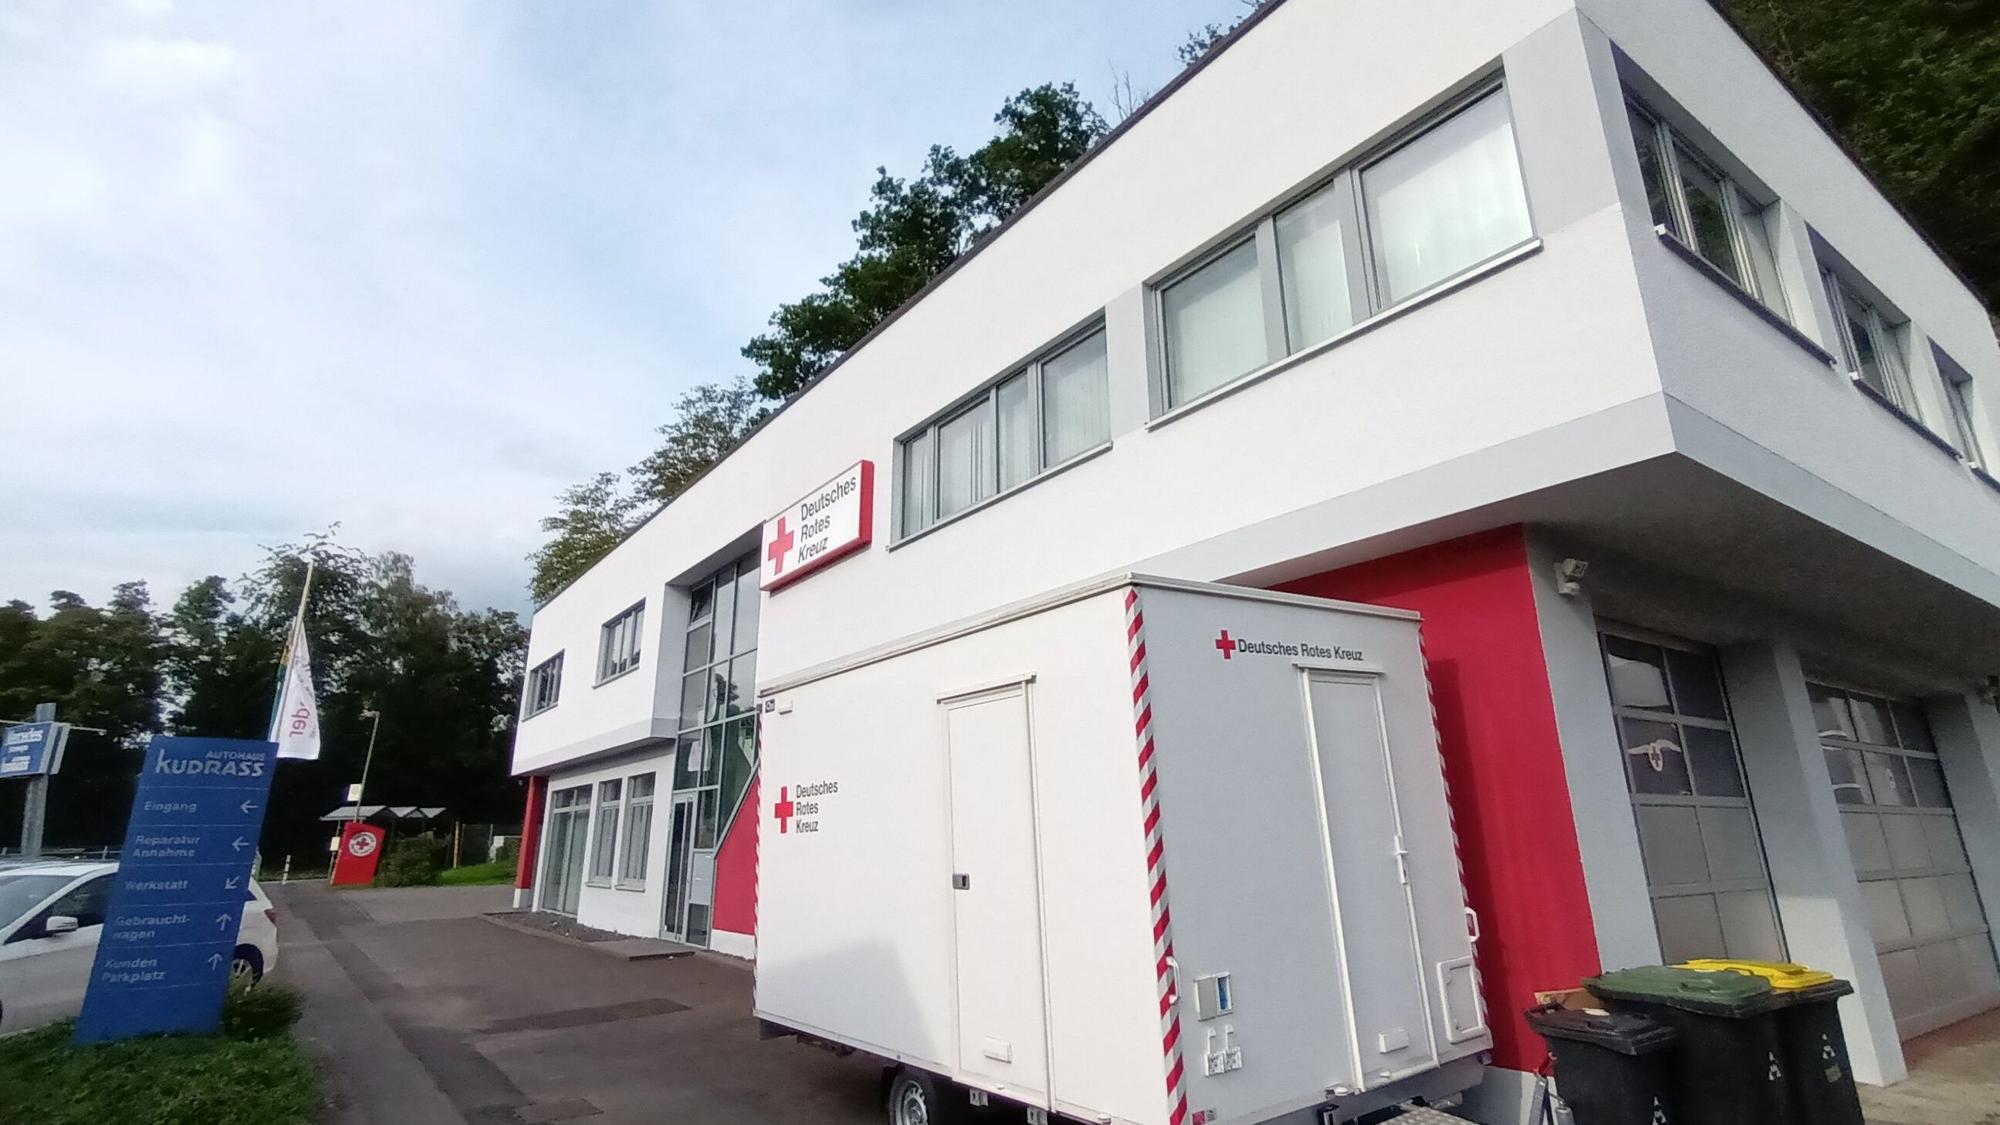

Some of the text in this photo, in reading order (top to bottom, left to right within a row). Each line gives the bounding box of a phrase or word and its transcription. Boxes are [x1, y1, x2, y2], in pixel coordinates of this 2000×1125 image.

[800, 476, 857, 521] Deutsches
[800, 515, 831, 542] Rotes
[798, 537, 829, 563] Kreuz
[1237, 638, 1363, 661] Deutsches Rotes Kreuz
[205, 750, 266, 761] AUTOHAUS
[796, 780, 838, 798] Deutsches
[143, 801, 198, 814] Eingang
[796, 801, 818, 816] Rotes
[796, 819, 818, 833] Kreuz
[135, 835, 201, 846] Reparatur
[132, 848, 196, 857] Annahme
[124, 879, 189, 890] Werkstatt
